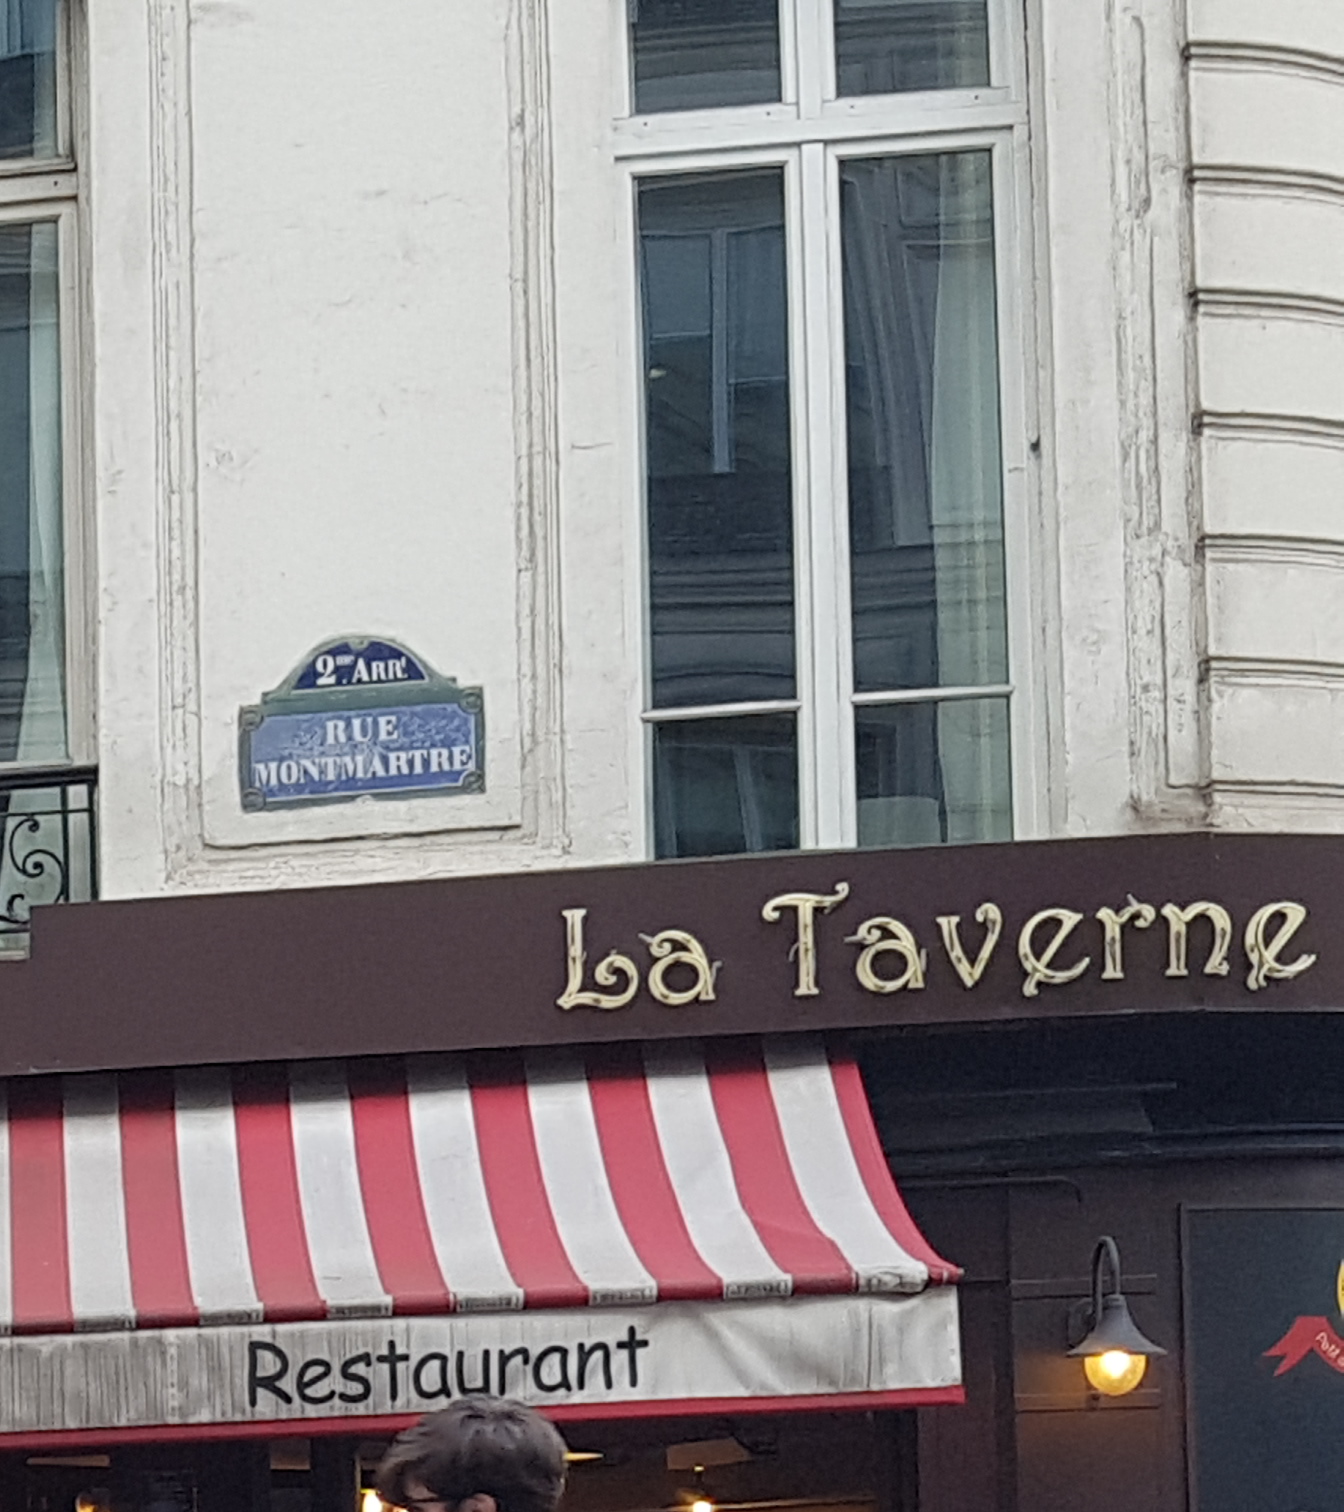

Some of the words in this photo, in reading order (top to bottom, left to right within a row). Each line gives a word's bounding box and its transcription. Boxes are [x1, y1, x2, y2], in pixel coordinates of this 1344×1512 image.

[325, 714, 400, 745] RUE
[253, 745, 474, 787] MONTMARTRE
[556, 908, 720, 1009] La
[762, 881, 1317, 997] Taverne
[247, 1324, 650, 1408] Restaurant
